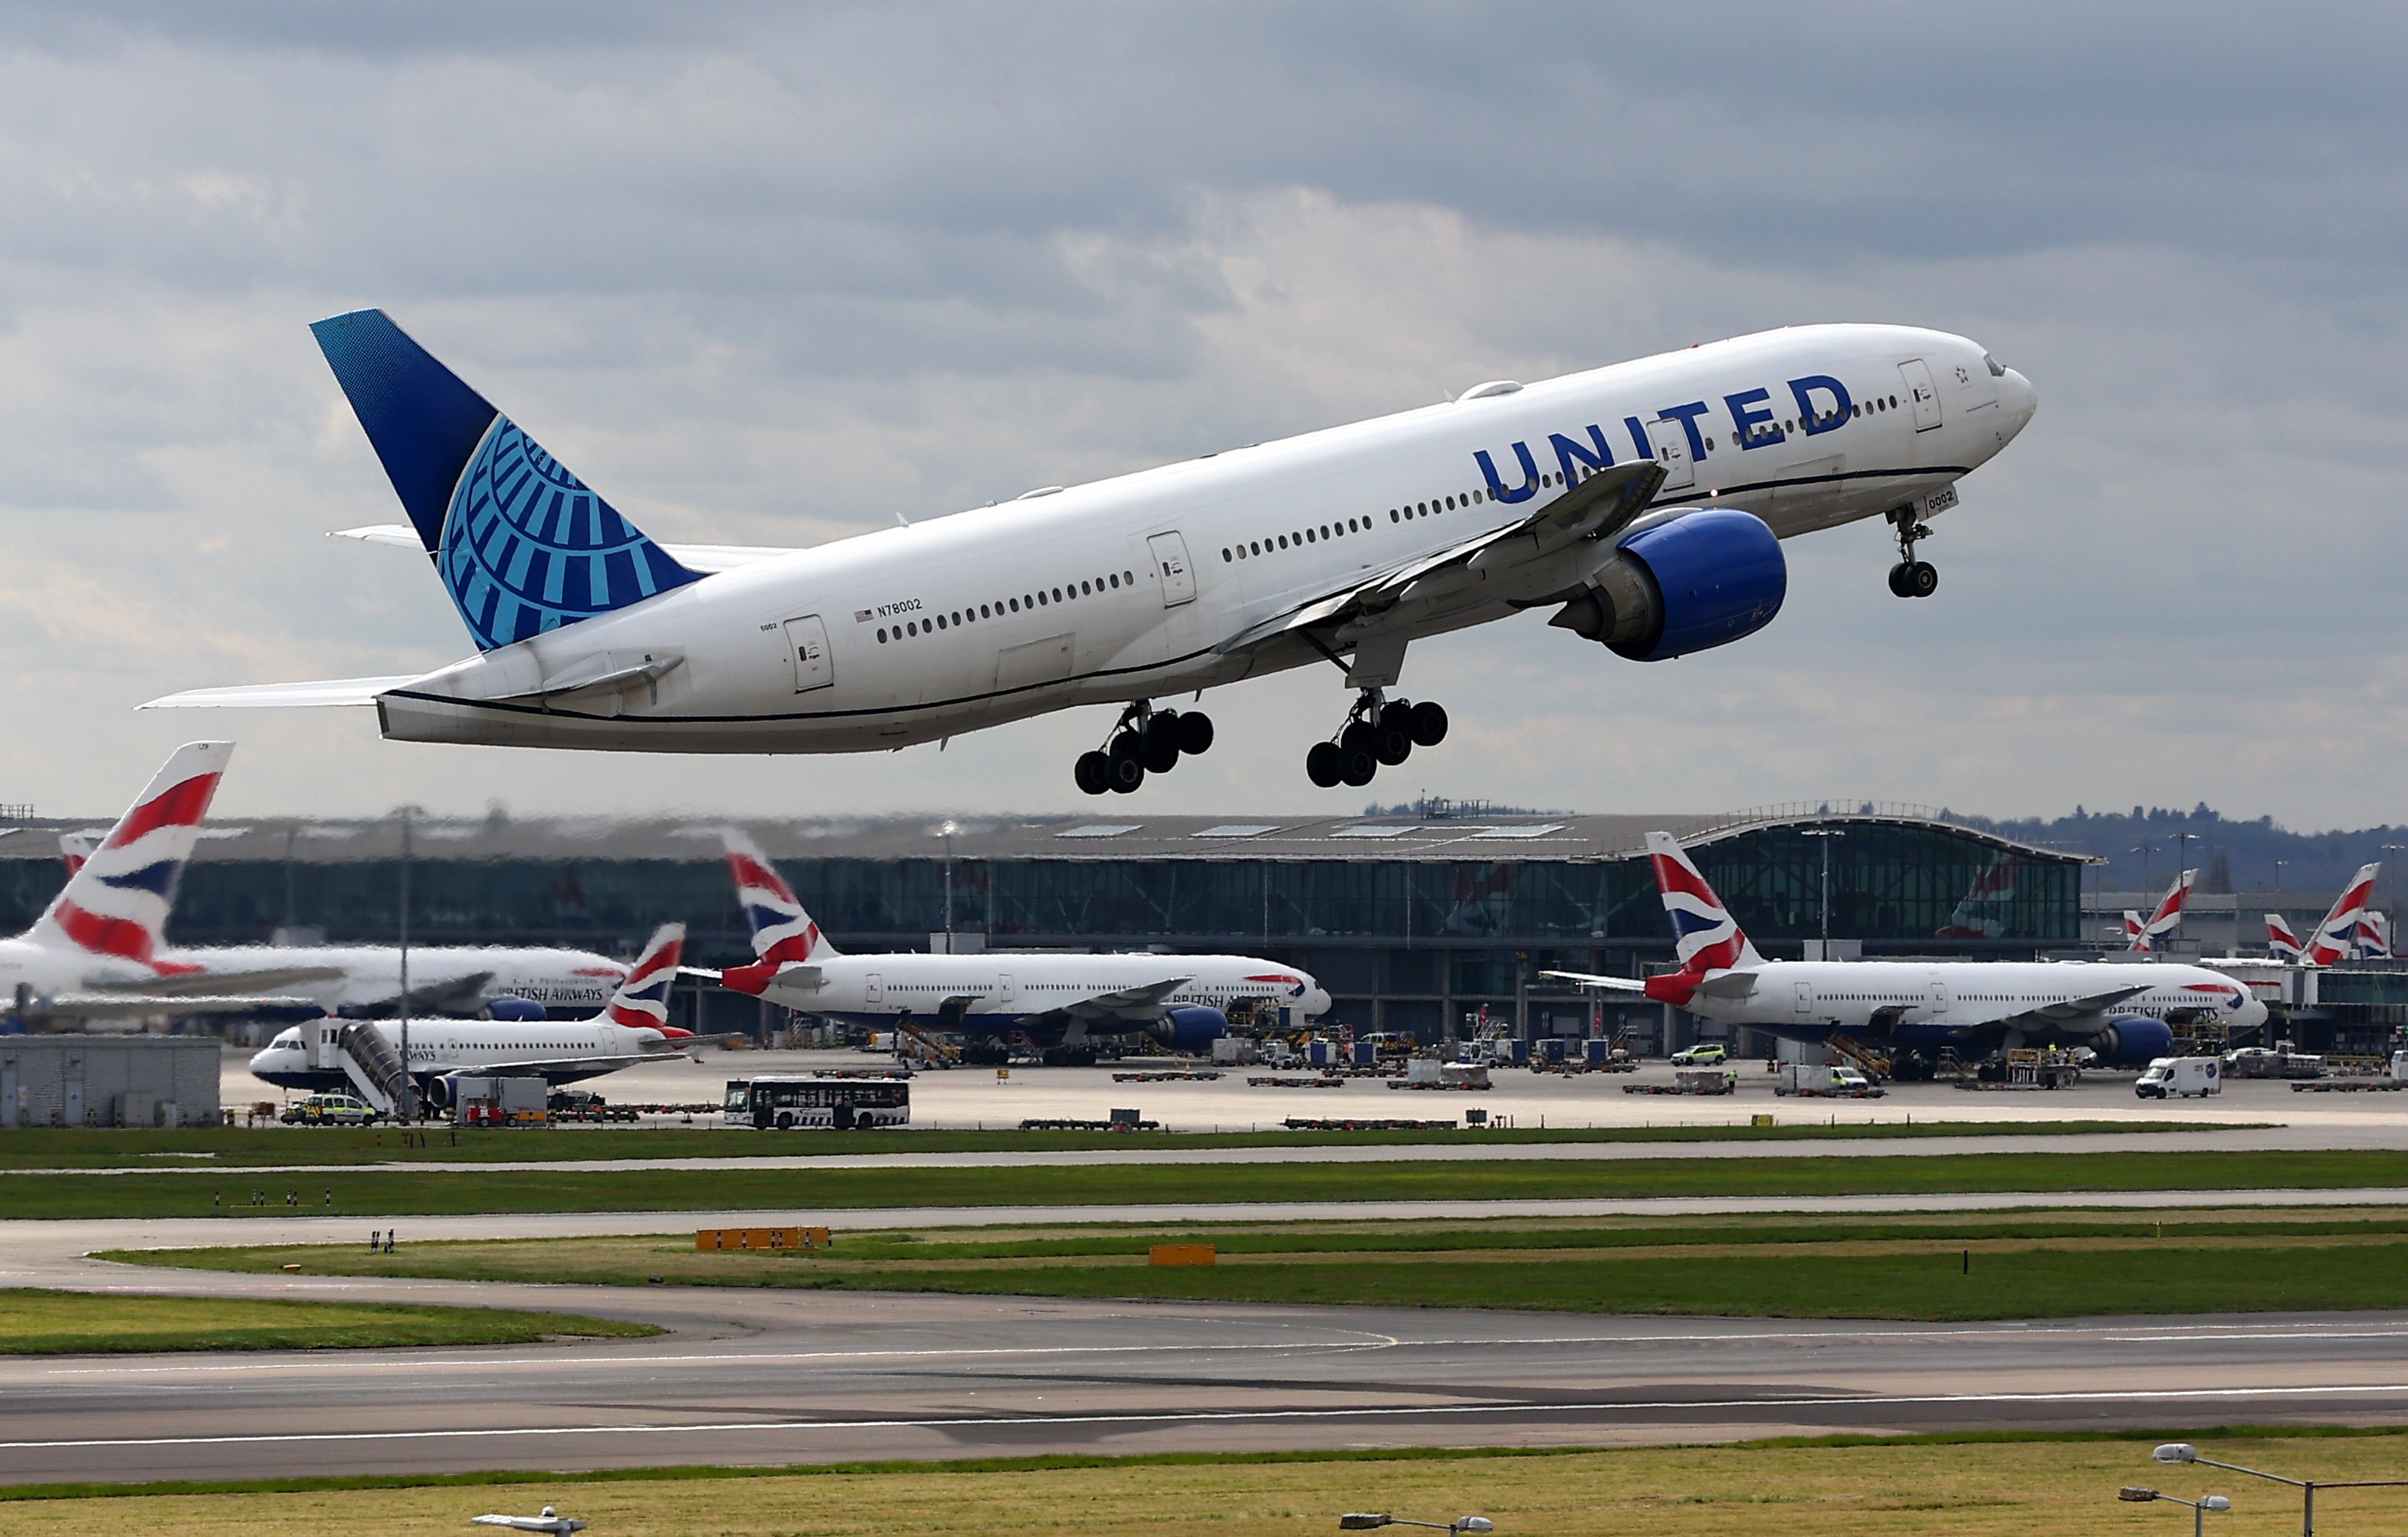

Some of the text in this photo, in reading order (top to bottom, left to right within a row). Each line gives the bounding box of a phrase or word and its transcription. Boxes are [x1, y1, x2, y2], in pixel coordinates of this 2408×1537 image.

[1471, 374, 1852, 504] UNITED
[1928, 491, 1954, 509] 0002
[877, 598, 923, 619] N78002
[550, 987, 604, 1001] AIRWAYS
